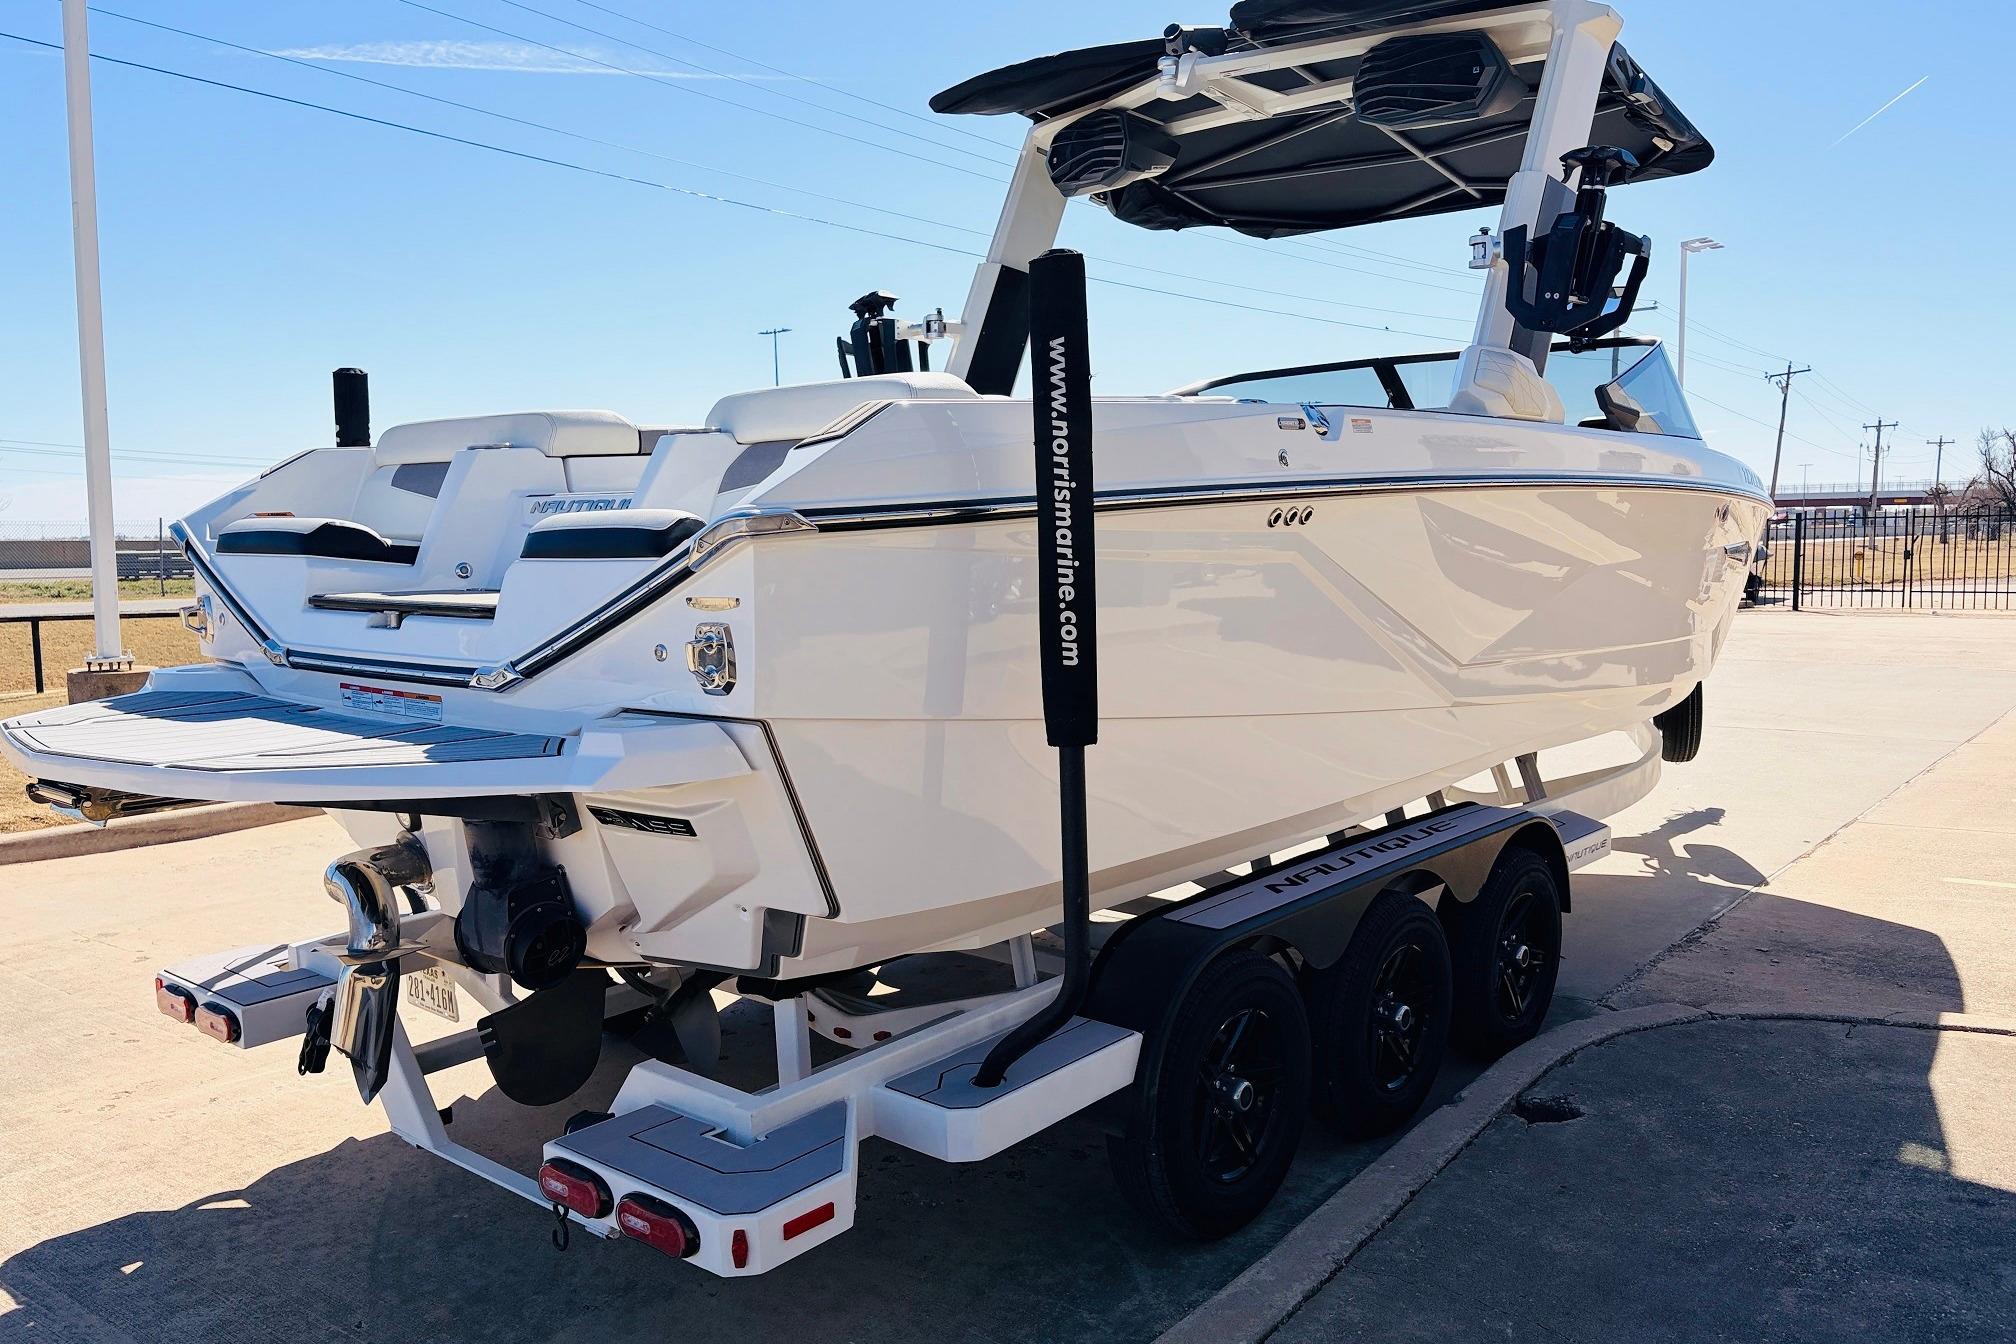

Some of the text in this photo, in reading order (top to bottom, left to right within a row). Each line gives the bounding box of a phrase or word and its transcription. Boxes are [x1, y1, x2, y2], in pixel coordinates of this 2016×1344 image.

[530, 499, 633, 513] NAUTIQU
[1049, 336, 1079, 666] www.norrismarine.com
[1264, 820, 1457, 894] NAUTIQUE
